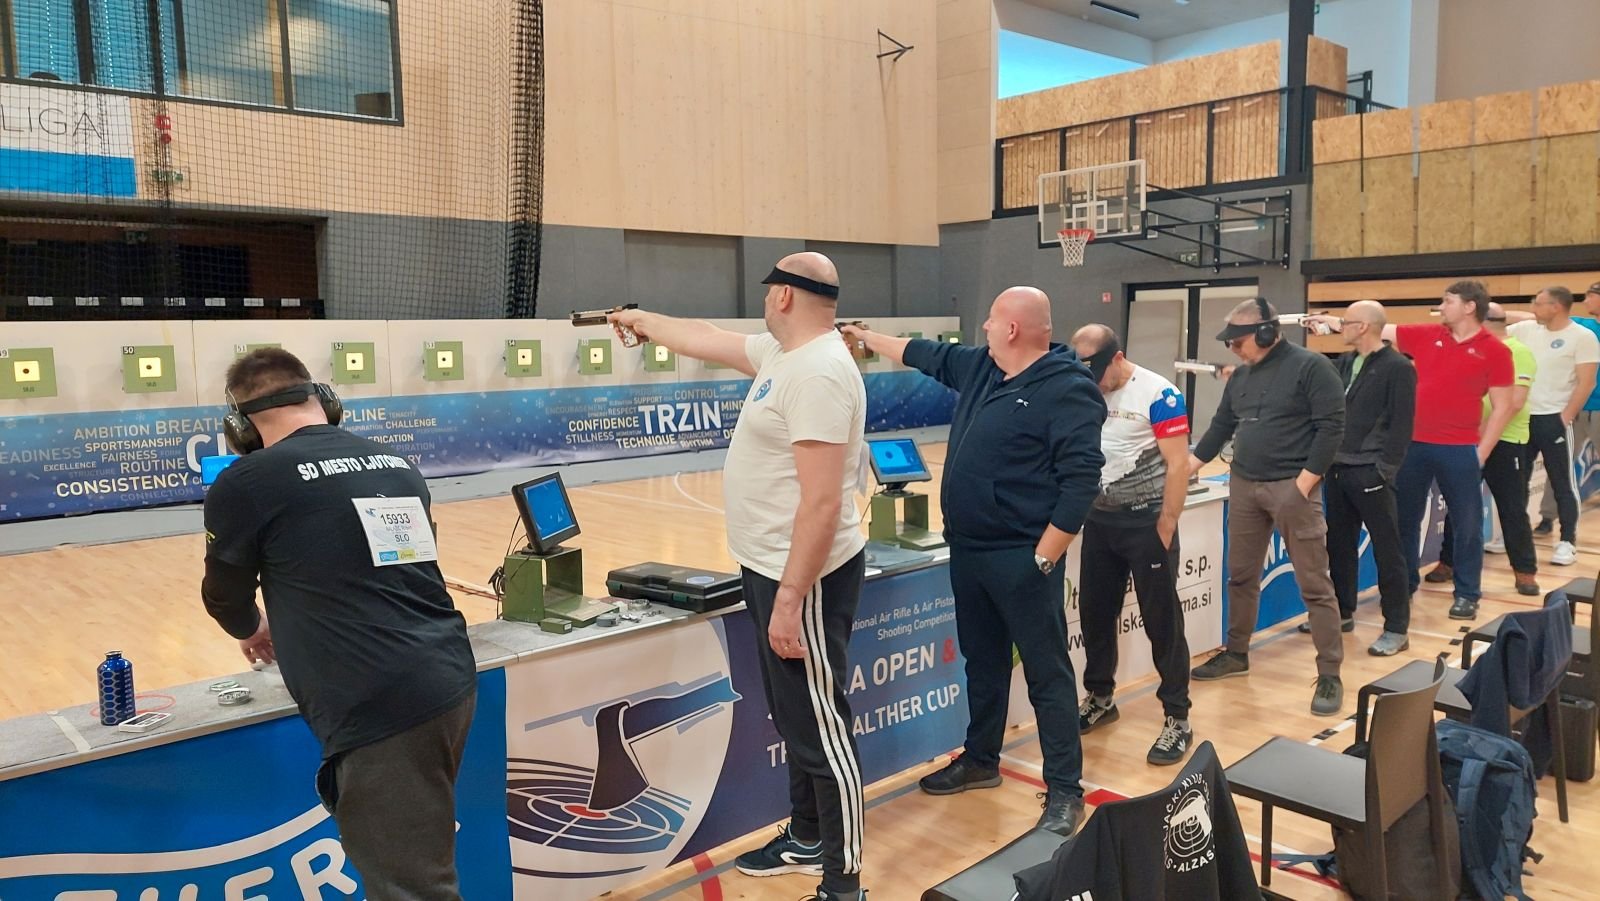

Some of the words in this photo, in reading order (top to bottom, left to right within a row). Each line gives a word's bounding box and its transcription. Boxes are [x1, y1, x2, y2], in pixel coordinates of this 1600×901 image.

[0, 103, 103, 139] LIGA
[634, 395, 662, 405] SUPPORT
[674, 388, 719, 400] CONTROL
[608, 407, 637, 416] RESPECT
[637, 401, 722, 435] TRZIN
[385, 418, 438, 430] CHALLENGE
[568, 416, 640, 432] CONFIDENCE
[73, 424, 150, 441] AMBITION
[368, 433, 414, 444] DICATION
[565, 431, 615, 445] STILLNESS
[677, 430, 721, 440] ADVANCEMENT
[84, 436, 183, 453] SPORTSMANSHIP
[391, 442, 435, 452] PIRATION
[615, 433, 677, 450] TECHNIQUE
[680, 438, 715, 449] RHYTHM
[101, 449, 158, 463] FAIRNESS
[43, 461, 97, 472] EXCELLENCE
[120, 457, 187, 474] ROUTINE
[297, 462, 320, 481] SD
[319, 457, 363, 477] MESTO
[358, 454, 411, 471] LJUTO
[56, 472, 189, 498] CONSISTENCY
[120, 487, 194, 502] CONNECTION
[380, 512, 411, 525] 15933
[394, 533, 410, 543] SLO
[1185, 555, 1212, 578] s.p.
[879, 611, 891, 624] Air
[893, 606, 912, 620] Rifle
[913, 603, 920, 615] &
[921, 600, 934, 612] Air
[877, 623, 913, 641] Shooting
[872, 641, 936, 686] OPEN
[942, 636, 957, 664] &
[852, 695, 923, 738] ALTHER
[926, 683, 961, 712] CUP
[1177, 849, 1215, 873] ALZAS
